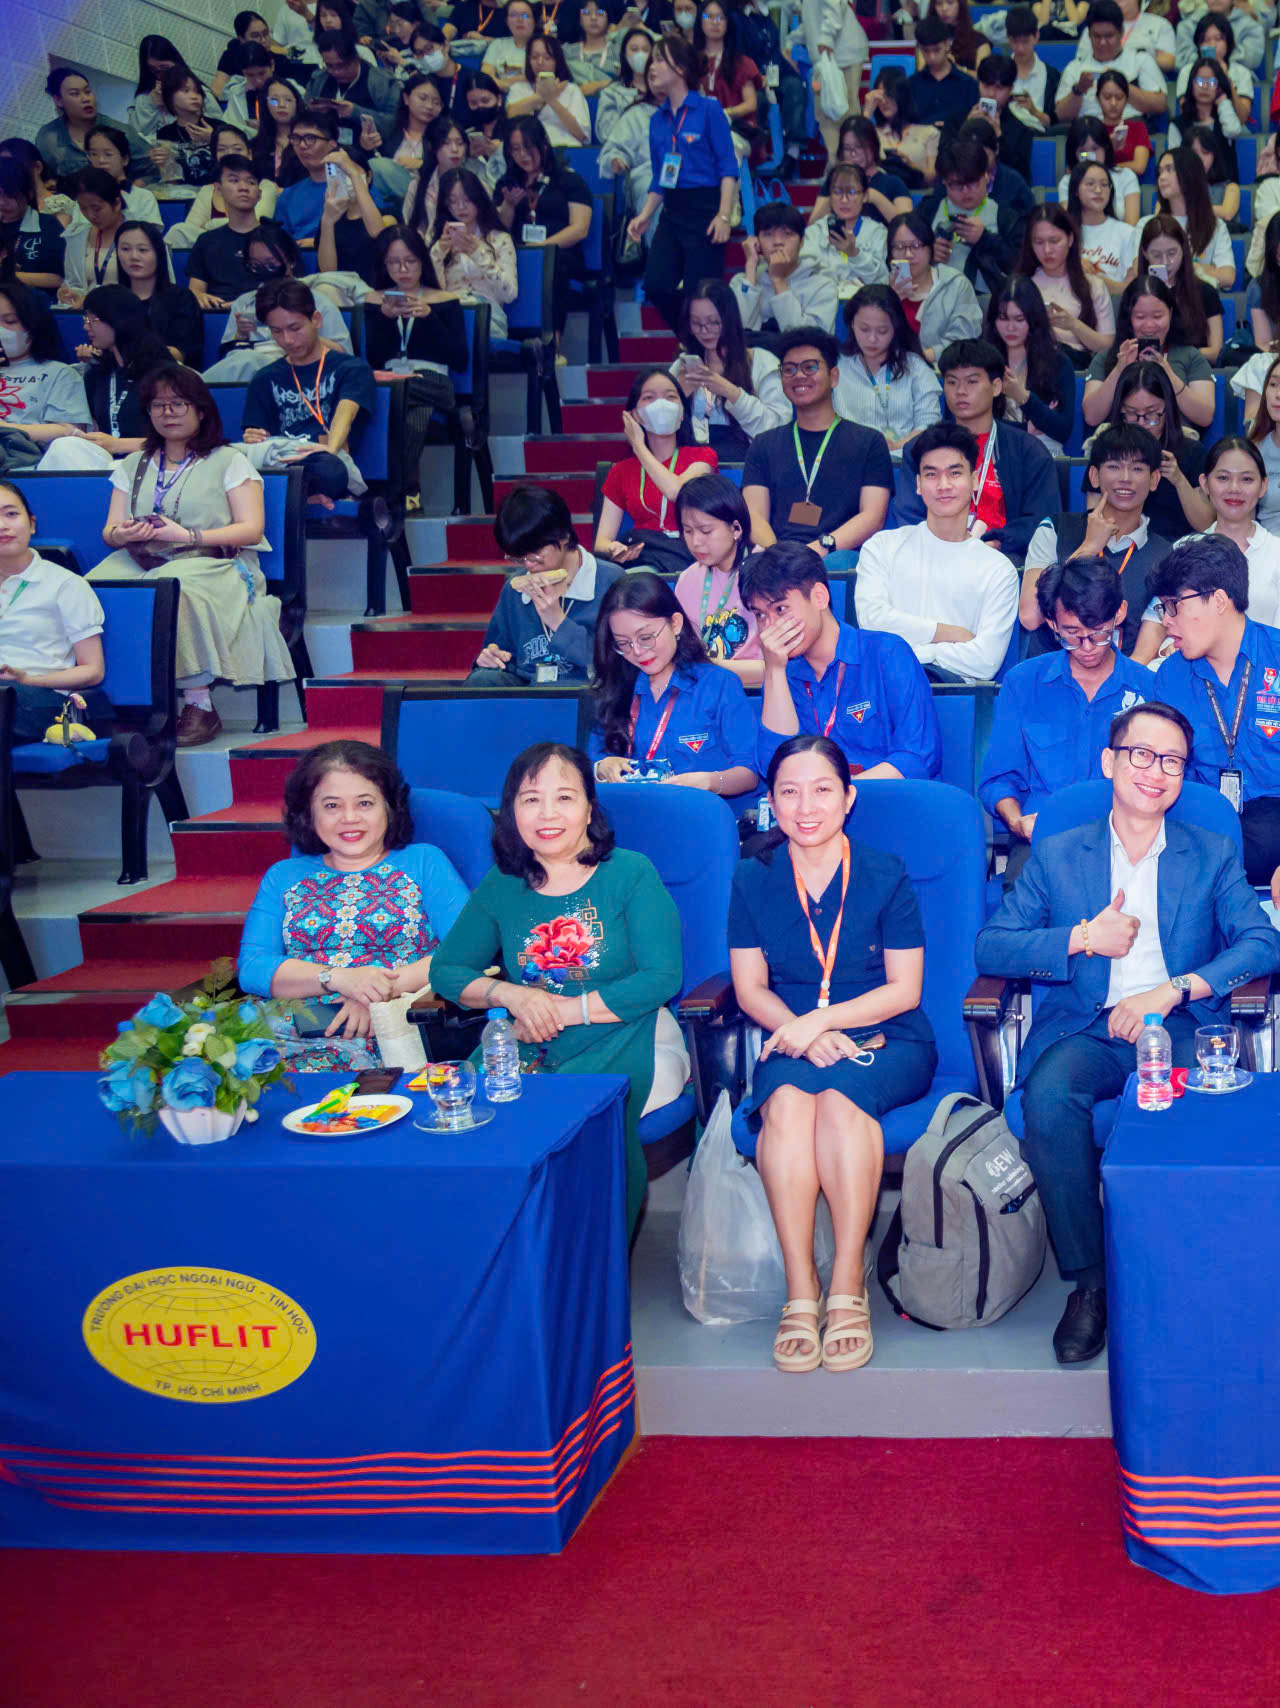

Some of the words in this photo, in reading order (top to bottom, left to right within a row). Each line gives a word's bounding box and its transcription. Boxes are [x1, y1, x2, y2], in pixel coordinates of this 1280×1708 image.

[147, 1274, 176, 1287] HỌC
[269, 1292, 289, 1312] TIN
[123, 1323, 277, 1348] HUFLIT
[227, 1382, 261, 1396] MINH
